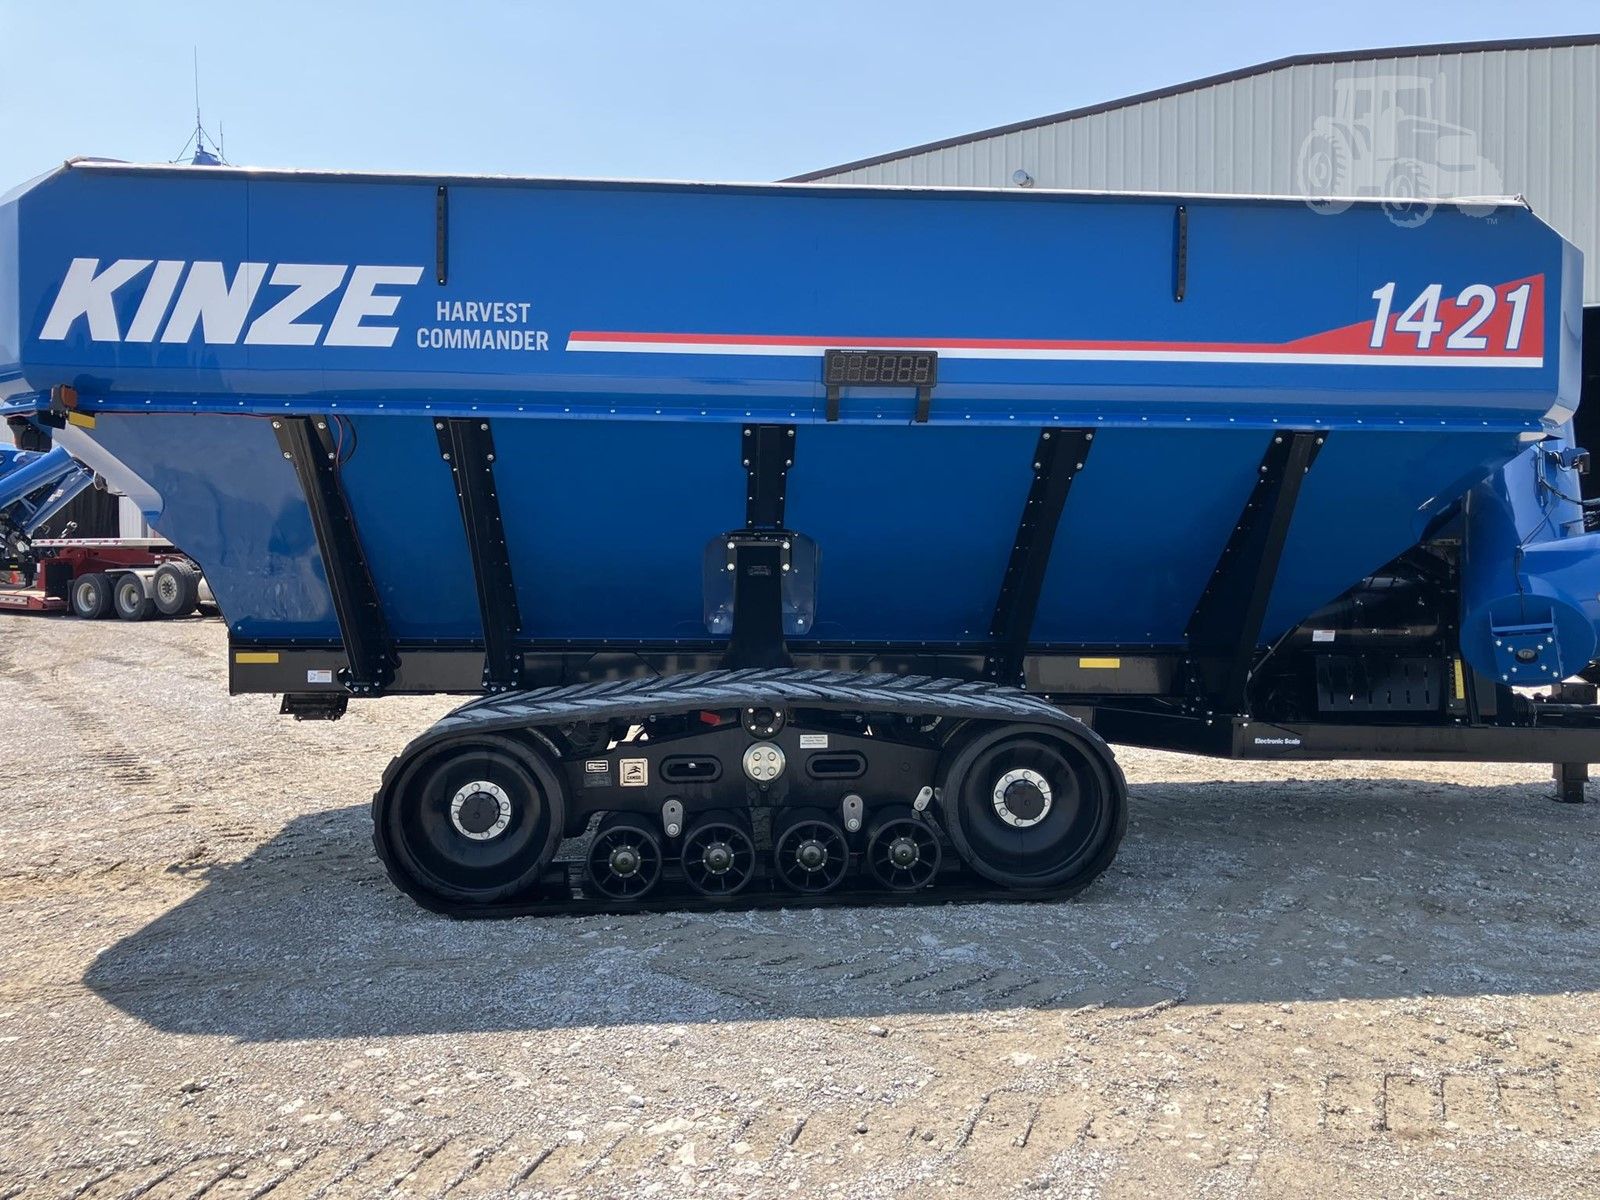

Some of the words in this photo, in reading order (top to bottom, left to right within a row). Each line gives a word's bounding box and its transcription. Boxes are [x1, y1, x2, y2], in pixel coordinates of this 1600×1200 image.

[38, 257, 425, 348] KINZE
[436, 301, 531, 324] HARVEST
[1369, 281, 1531, 351] 1421
[416, 328, 549, 352] COMMANDER
